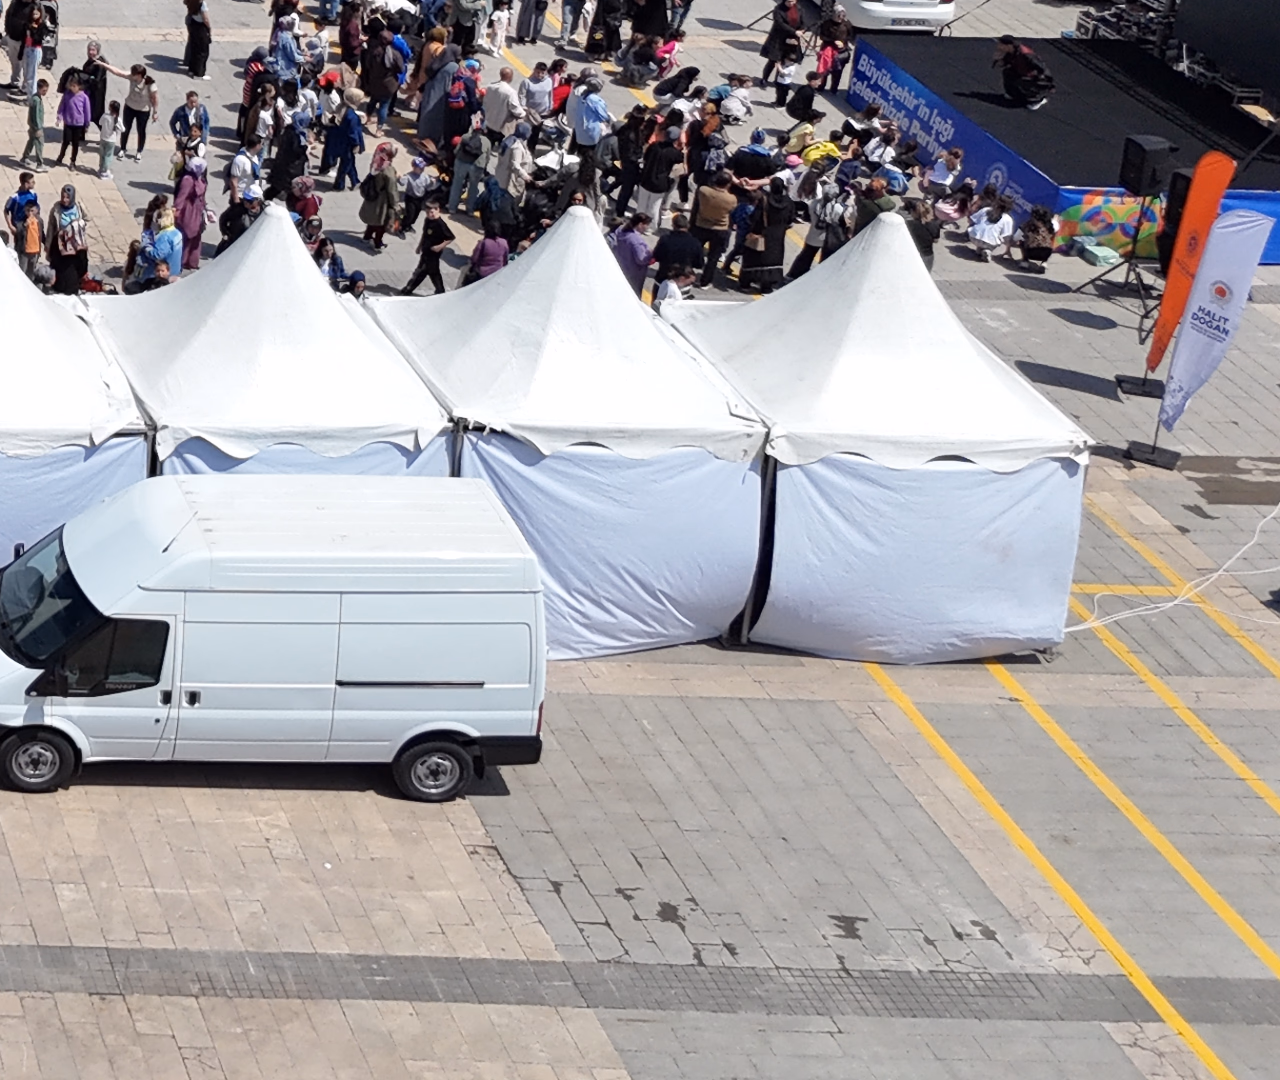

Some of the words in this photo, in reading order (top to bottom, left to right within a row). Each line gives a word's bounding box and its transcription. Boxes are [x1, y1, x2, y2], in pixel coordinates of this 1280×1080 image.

[857, 53, 931, 122] Büyükşehir'in
[1190, 311, 1230, 338] DOĞAN
[1197, 304, 1230, 326] HALİT
